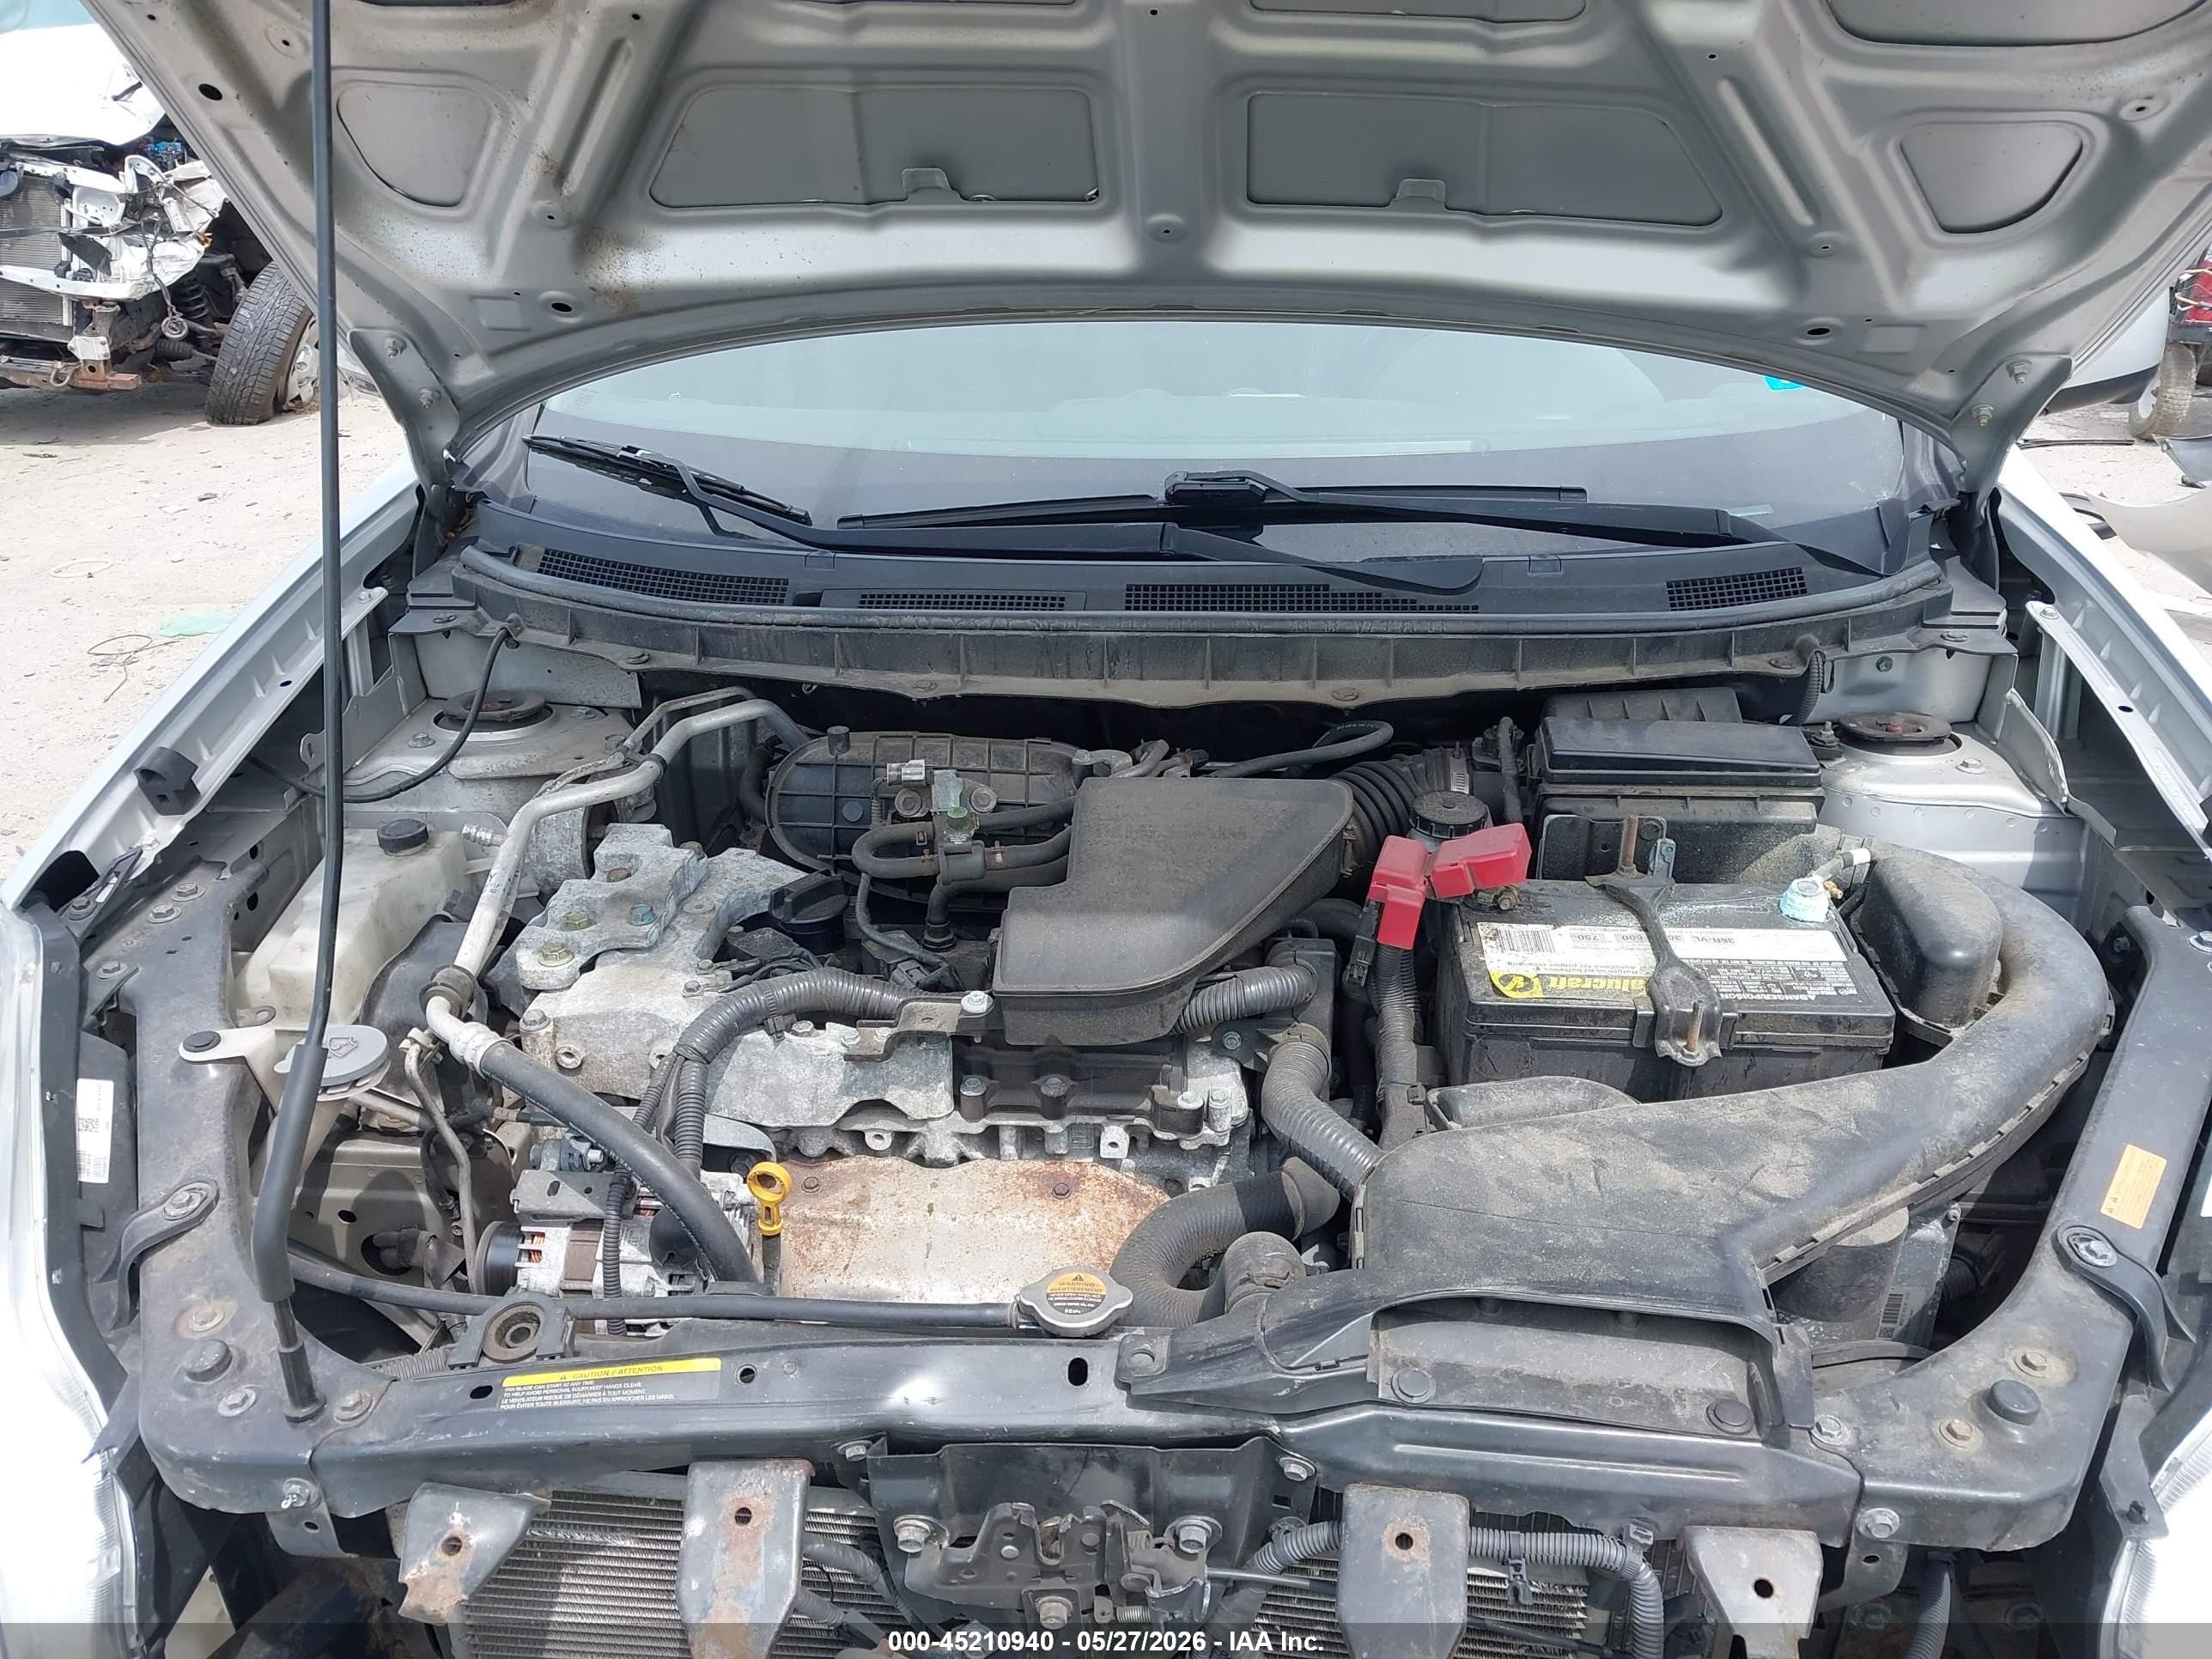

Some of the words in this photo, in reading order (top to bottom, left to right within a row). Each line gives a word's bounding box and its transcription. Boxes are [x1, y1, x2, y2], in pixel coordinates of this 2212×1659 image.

[1690, 935, 1735, 944] 36R-VL
[1548, 975, 1648, 992] alucraft
[573, 1370, 610, 1380] CAUTION
[617, 1364, 664, 1375] ATTENTION
[509, 1395, 543, 1404] VENTILATEUR
